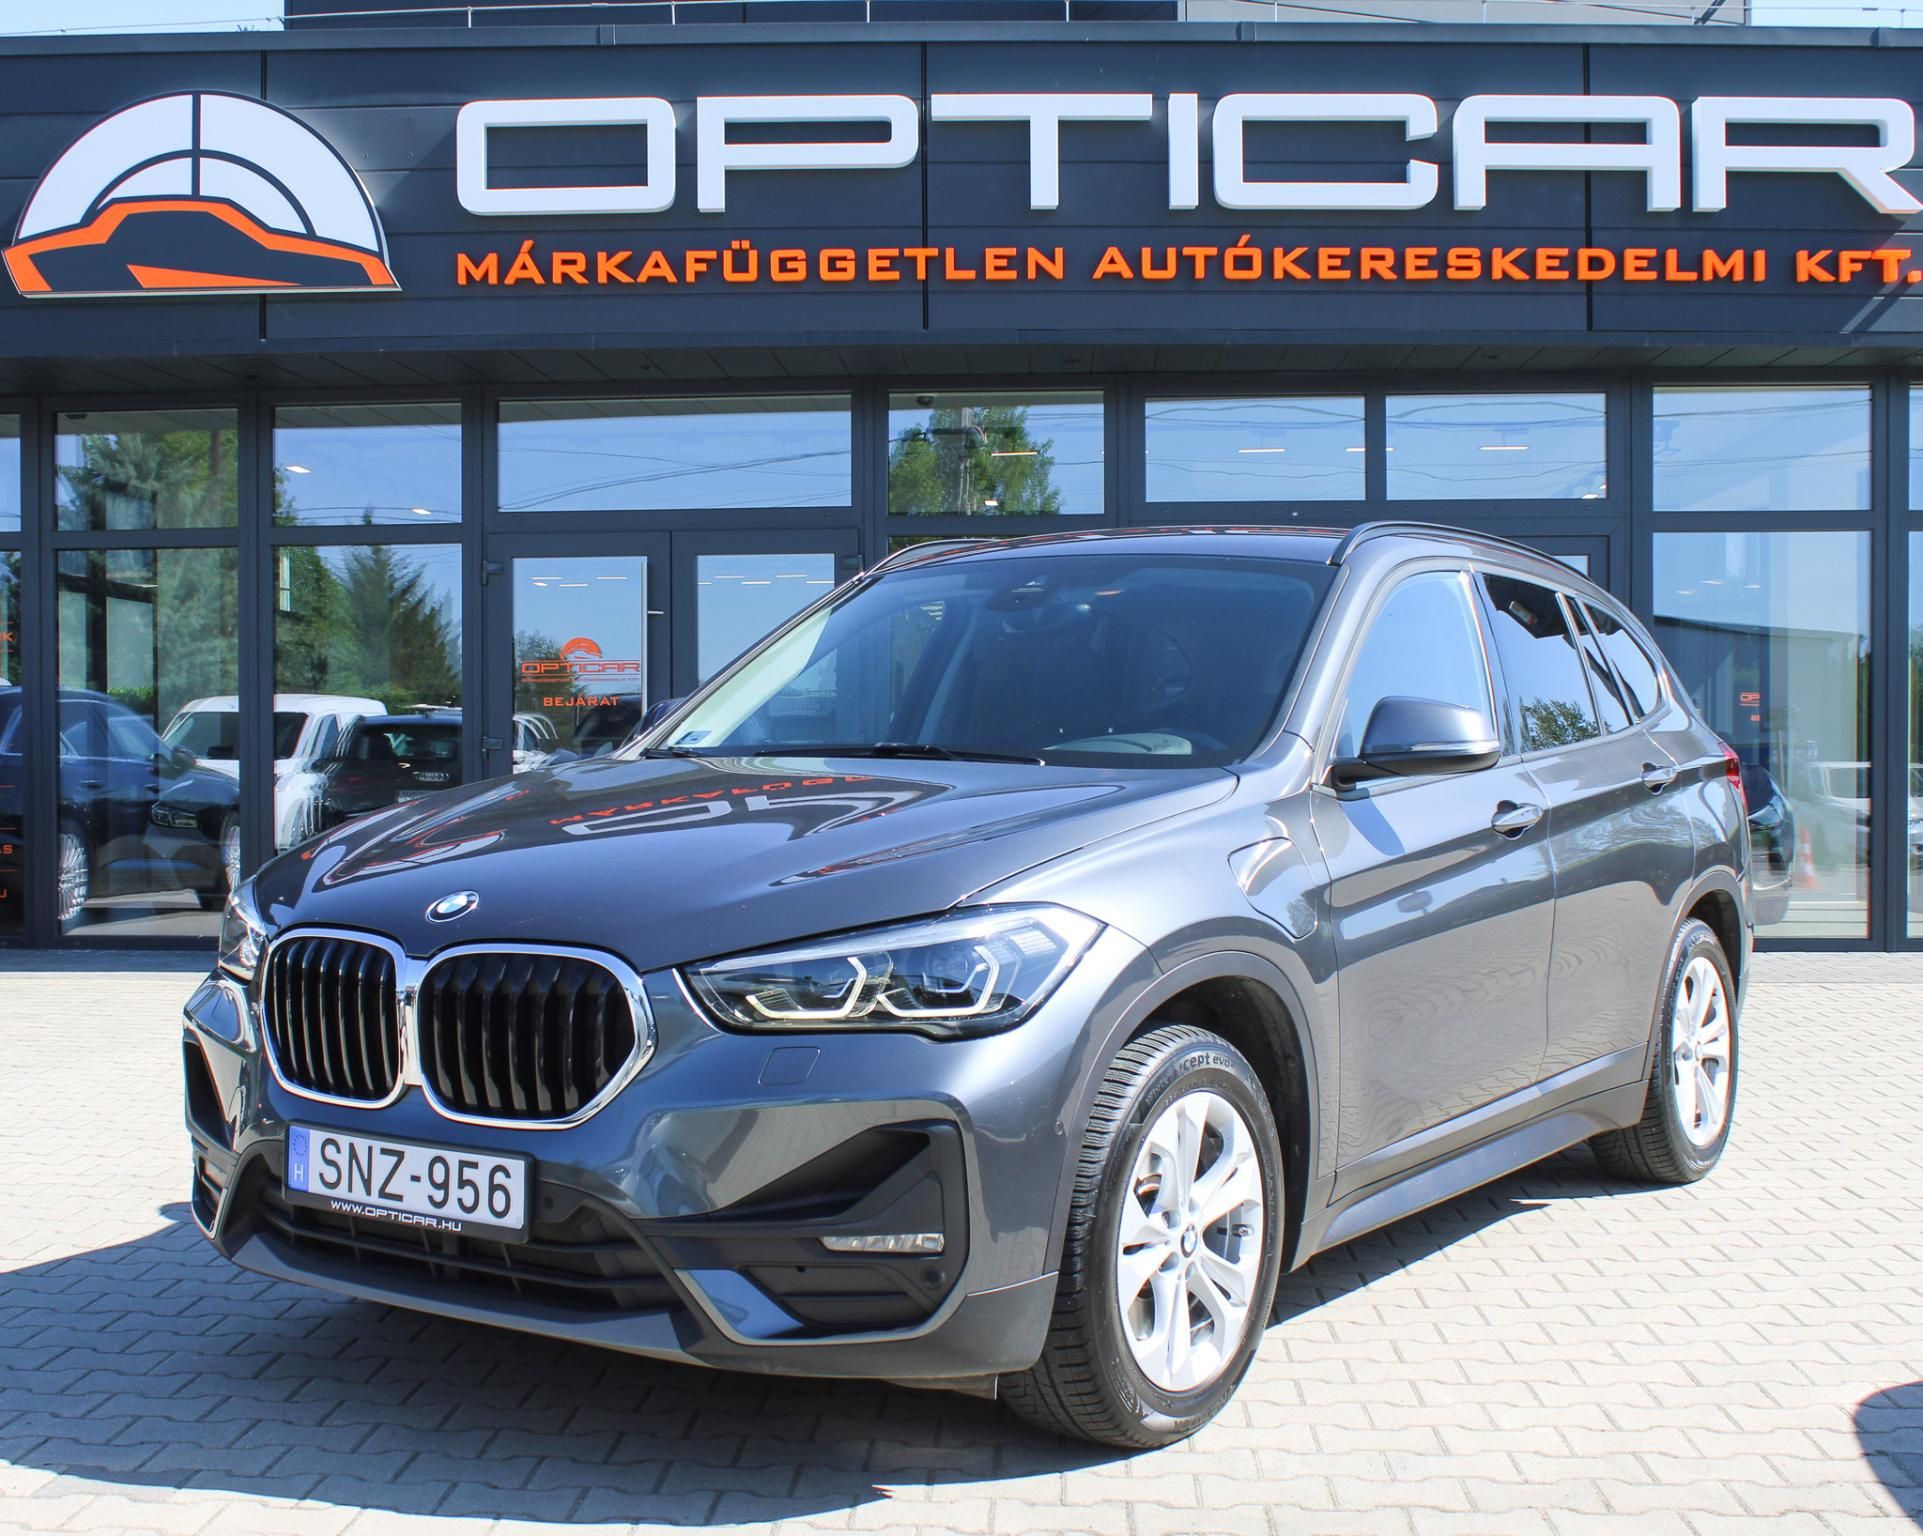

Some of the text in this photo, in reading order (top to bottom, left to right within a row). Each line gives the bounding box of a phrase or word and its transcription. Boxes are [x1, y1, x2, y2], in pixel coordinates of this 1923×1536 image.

[456, 93, 1923, 215] OPTICAR
[457, 234, 1923, 286] MÁRKAFÜGGETLEN AUTÓKERESKEDELMI KFT.
[521, 662, 640, 674] OPTICAR
[543, 694, 620, 707] BEJÁRAT
[293, 1164, 304, 1182] H
[319, 1138, 512, 1219] SNZ-956
